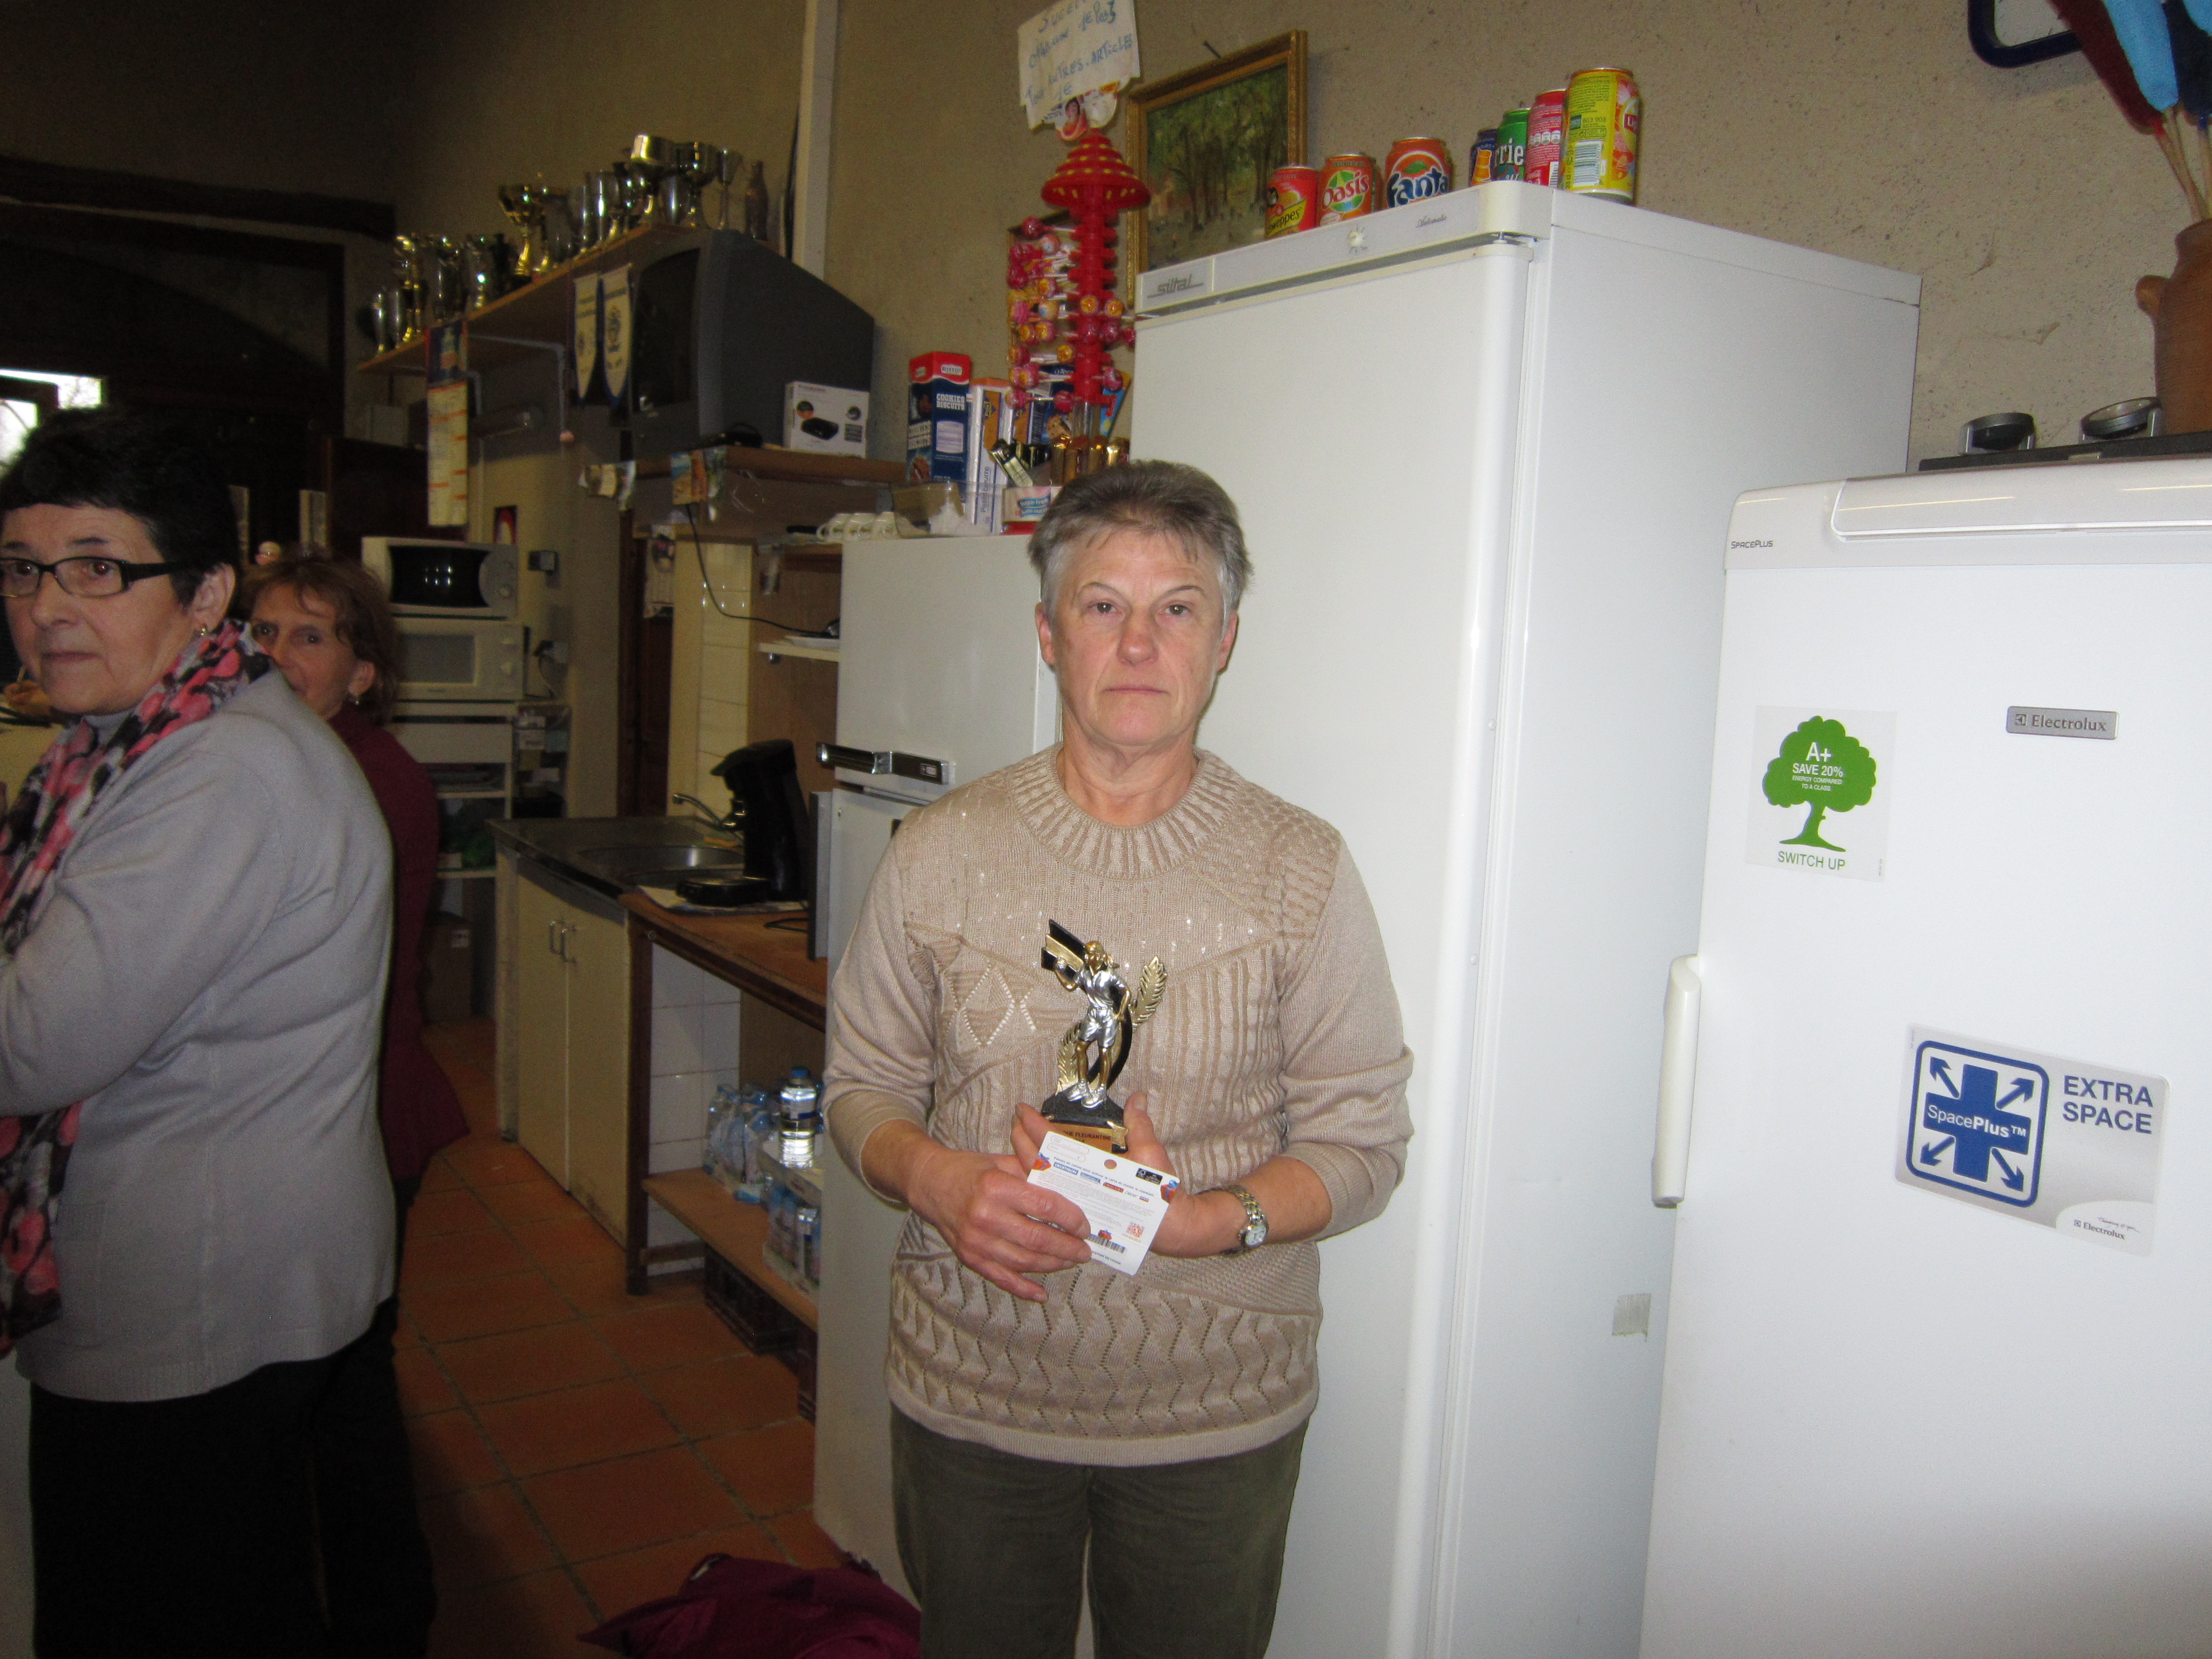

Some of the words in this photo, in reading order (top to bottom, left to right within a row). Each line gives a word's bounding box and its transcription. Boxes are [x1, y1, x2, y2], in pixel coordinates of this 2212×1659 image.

[1494, 138, 1524, 166] rrie
[937, 393, 965, 403] COOKIES
[937, 401, 965, 411] BISCUITS
[2032, 715, 2107, 731] Electrolux
[1805, 742, 1831, 762] A+
[1792, 763, 1819, 775] SAVE
[1821, 765, 1843, 777] 20%
[1814, 777, 1842, 785] COMPARED
[1778, 851, 1824, 868] SWITCH
[1828, 858, 1845, 870] UP
[2064, 1075, 2153, 1107] EXTRA
[2062, 1101, 2152, 1134] SPACE
[1075, 1132, 1111, 1141] FLEURANTINE
[2083, 1221, 2125, 1239] Electrolux
